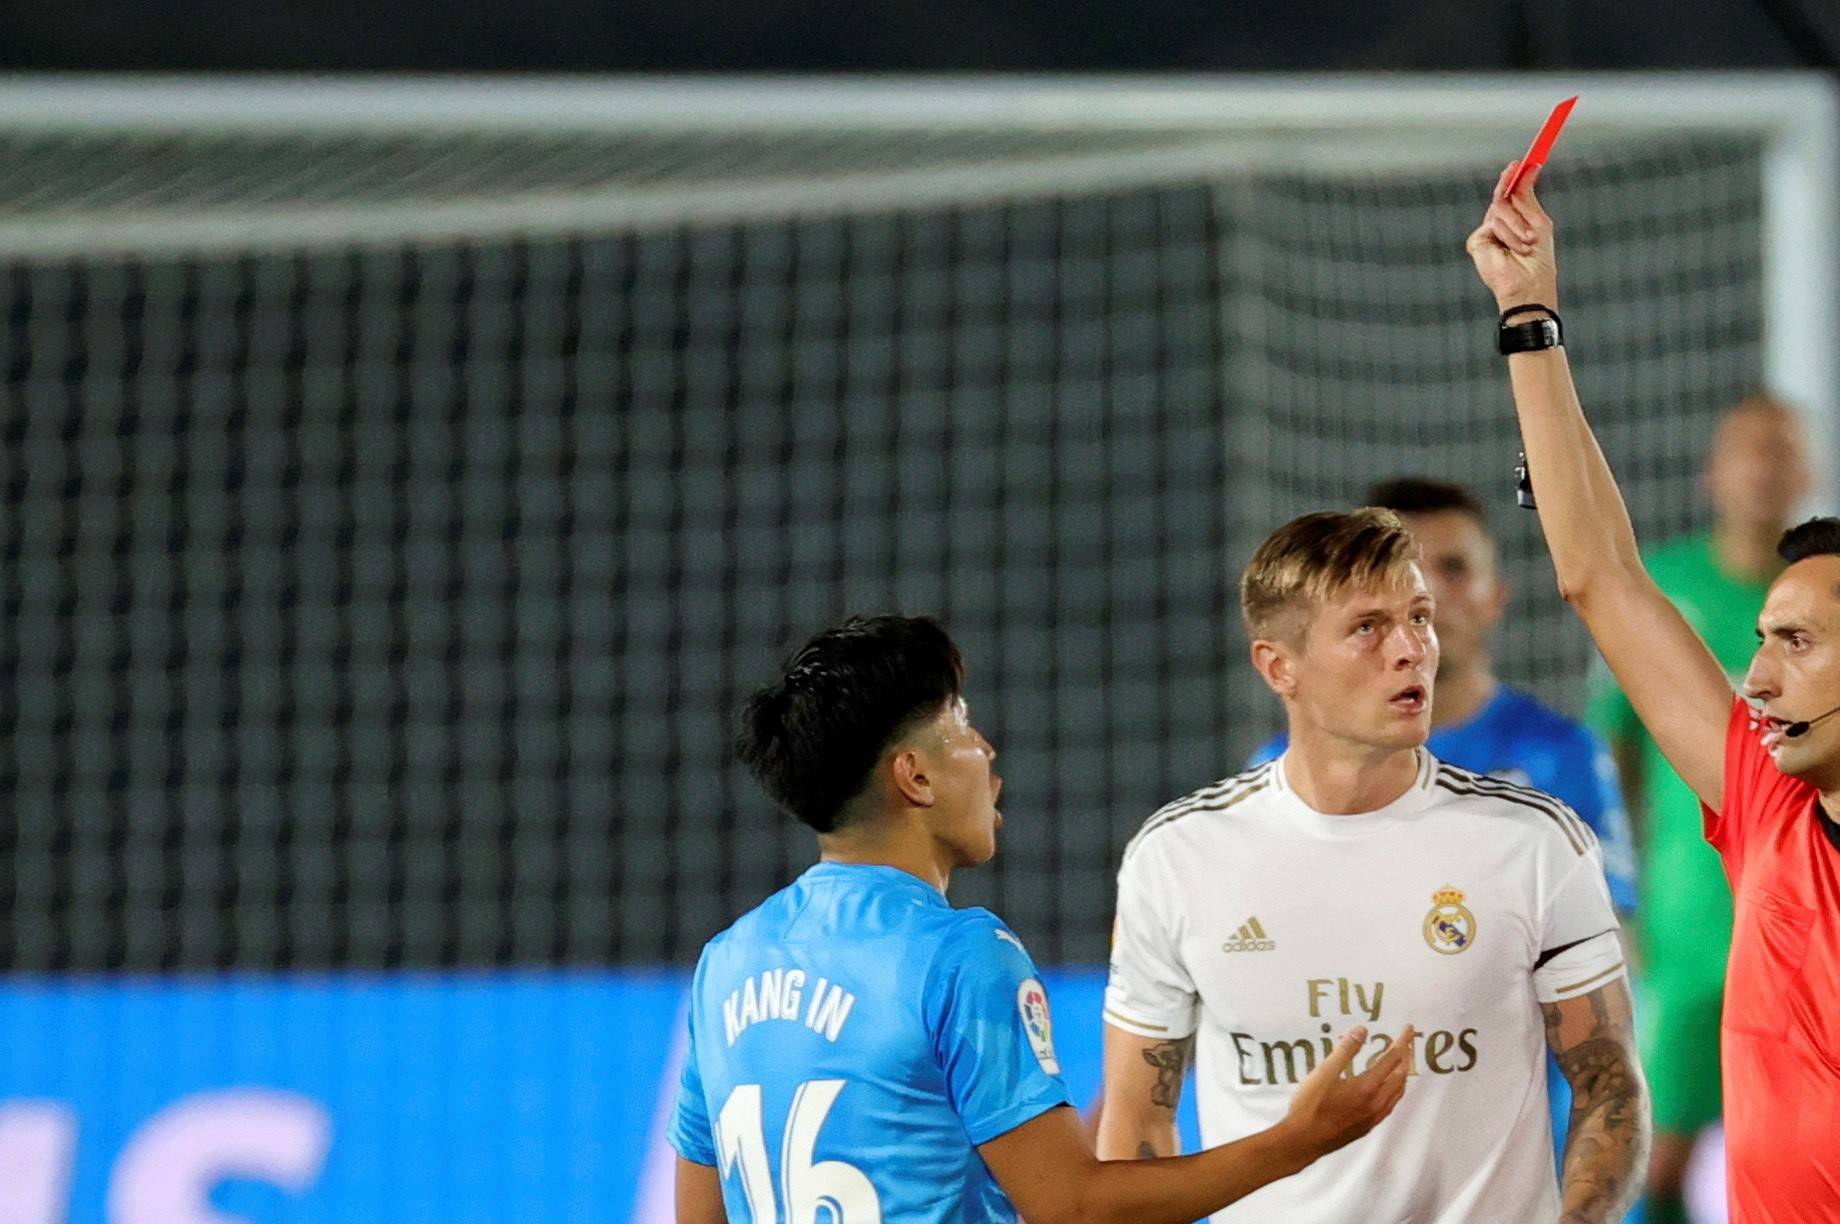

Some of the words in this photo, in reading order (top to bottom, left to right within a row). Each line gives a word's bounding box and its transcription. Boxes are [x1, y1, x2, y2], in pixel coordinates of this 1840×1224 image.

[723, 968, 806, 1047] KANG
[805, 977, 855, 1043] IN
[1306, 976, 1385, 1022] Fly
